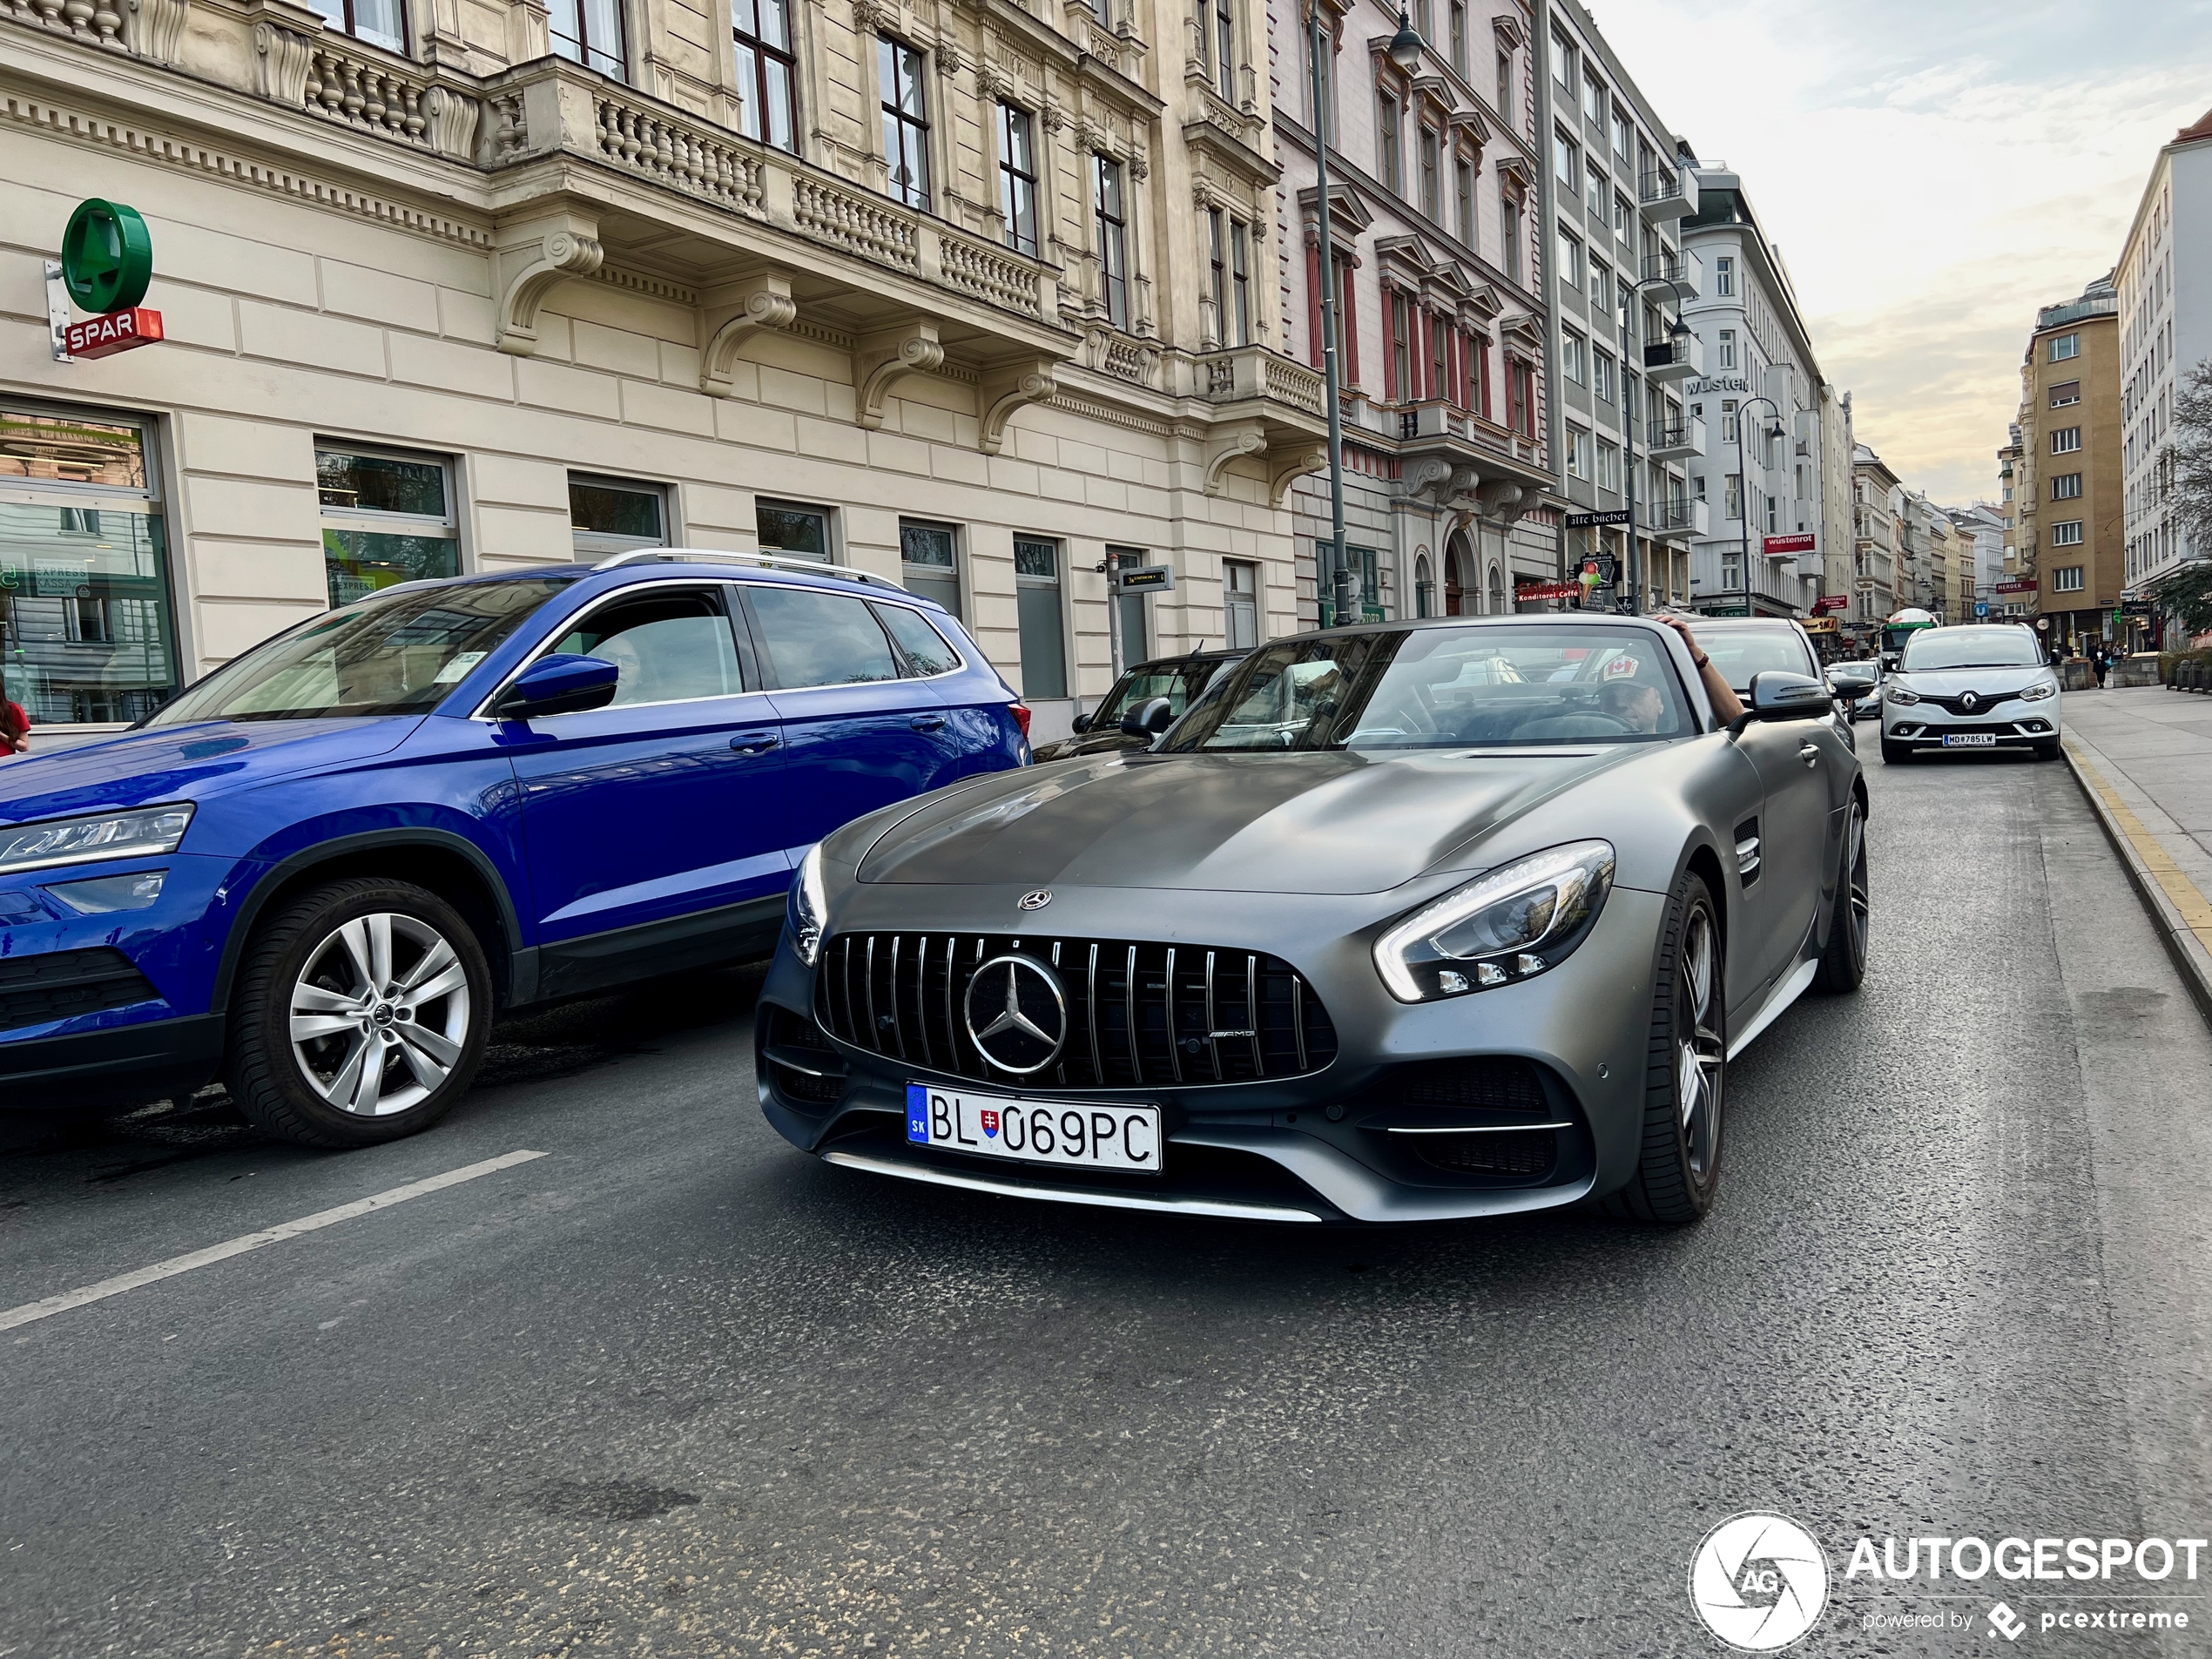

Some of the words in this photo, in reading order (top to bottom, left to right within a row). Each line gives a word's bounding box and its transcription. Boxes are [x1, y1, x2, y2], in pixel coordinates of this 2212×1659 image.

[71, 314, 132, 349] SPAR
[36, 567, 86, 577] EXPRESS
[1519, 592, 1556, 601] Konditorei
[1977, 607, 1986, 616] U
[912, 1120, 925, 1134] SK
[931, 1095, 978, 1145] BL
[1002, 1106, 1150, 1162] 069PC
